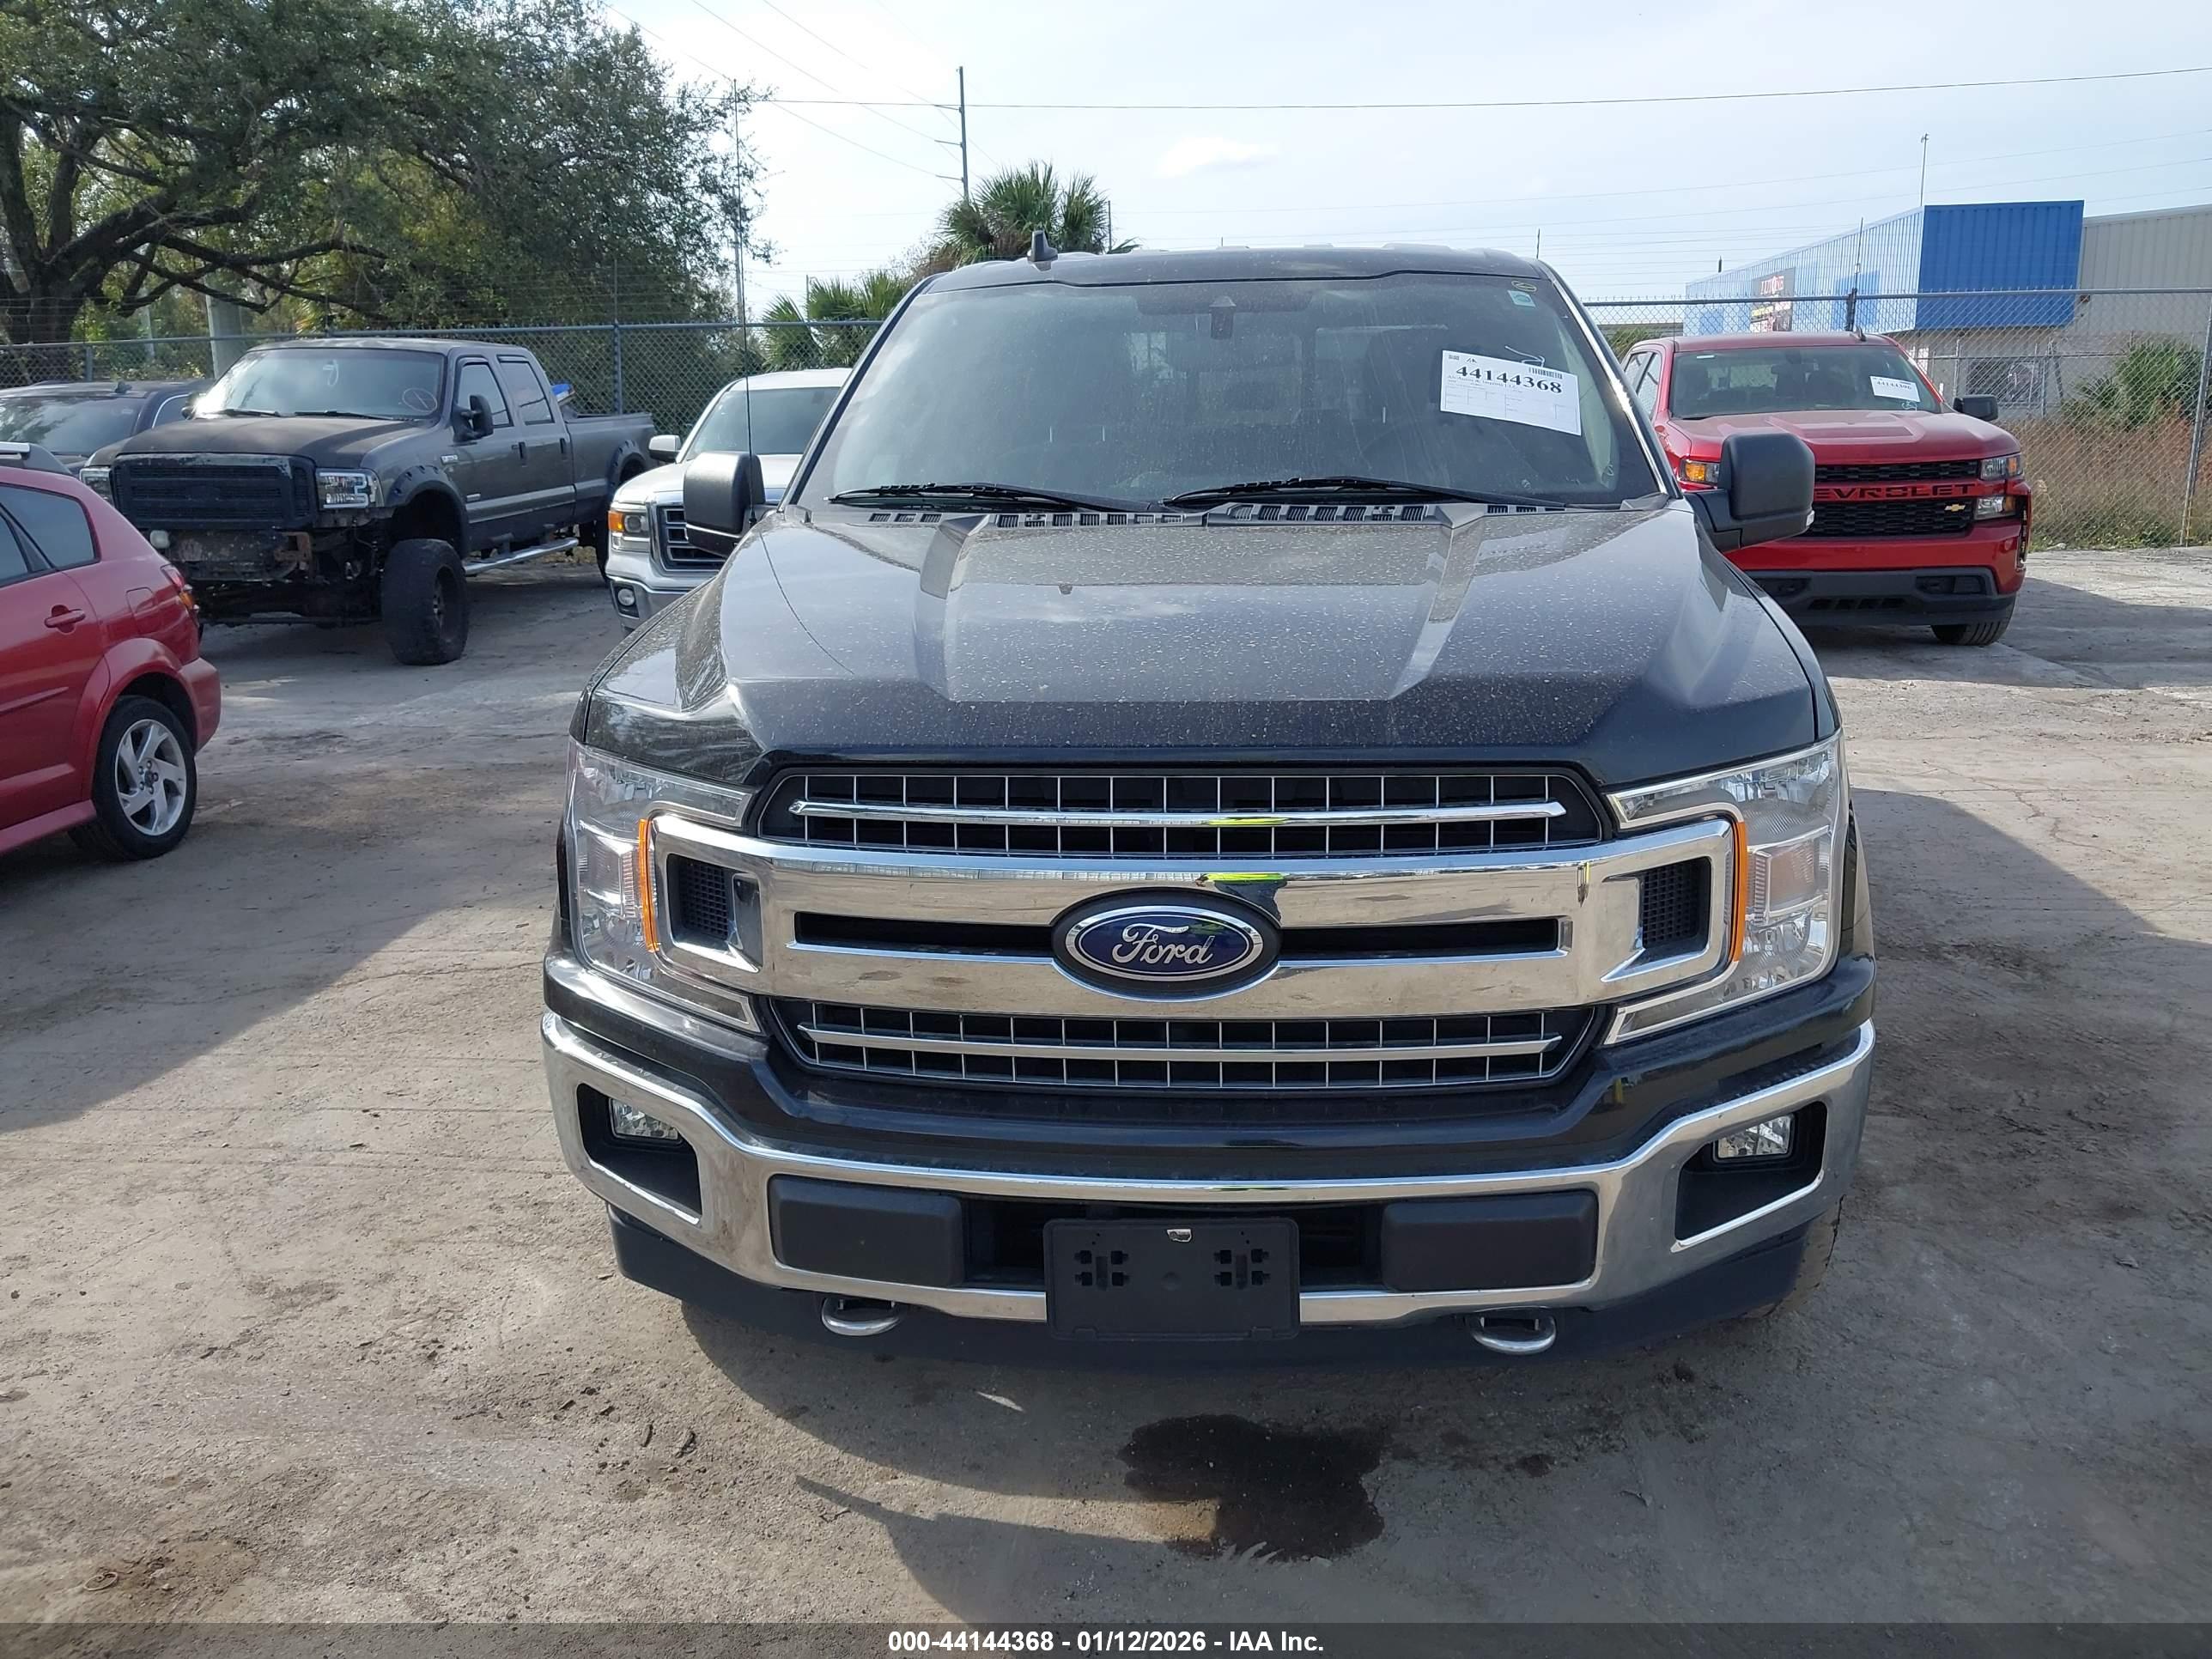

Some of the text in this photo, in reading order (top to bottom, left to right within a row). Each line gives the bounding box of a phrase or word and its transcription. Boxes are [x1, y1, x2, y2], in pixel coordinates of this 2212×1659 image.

[1455, 366, 1563, 394] 44144368
[1814, 483, 1976, 499] EVROLET
[1111, 922, 1215, 964] Ford
